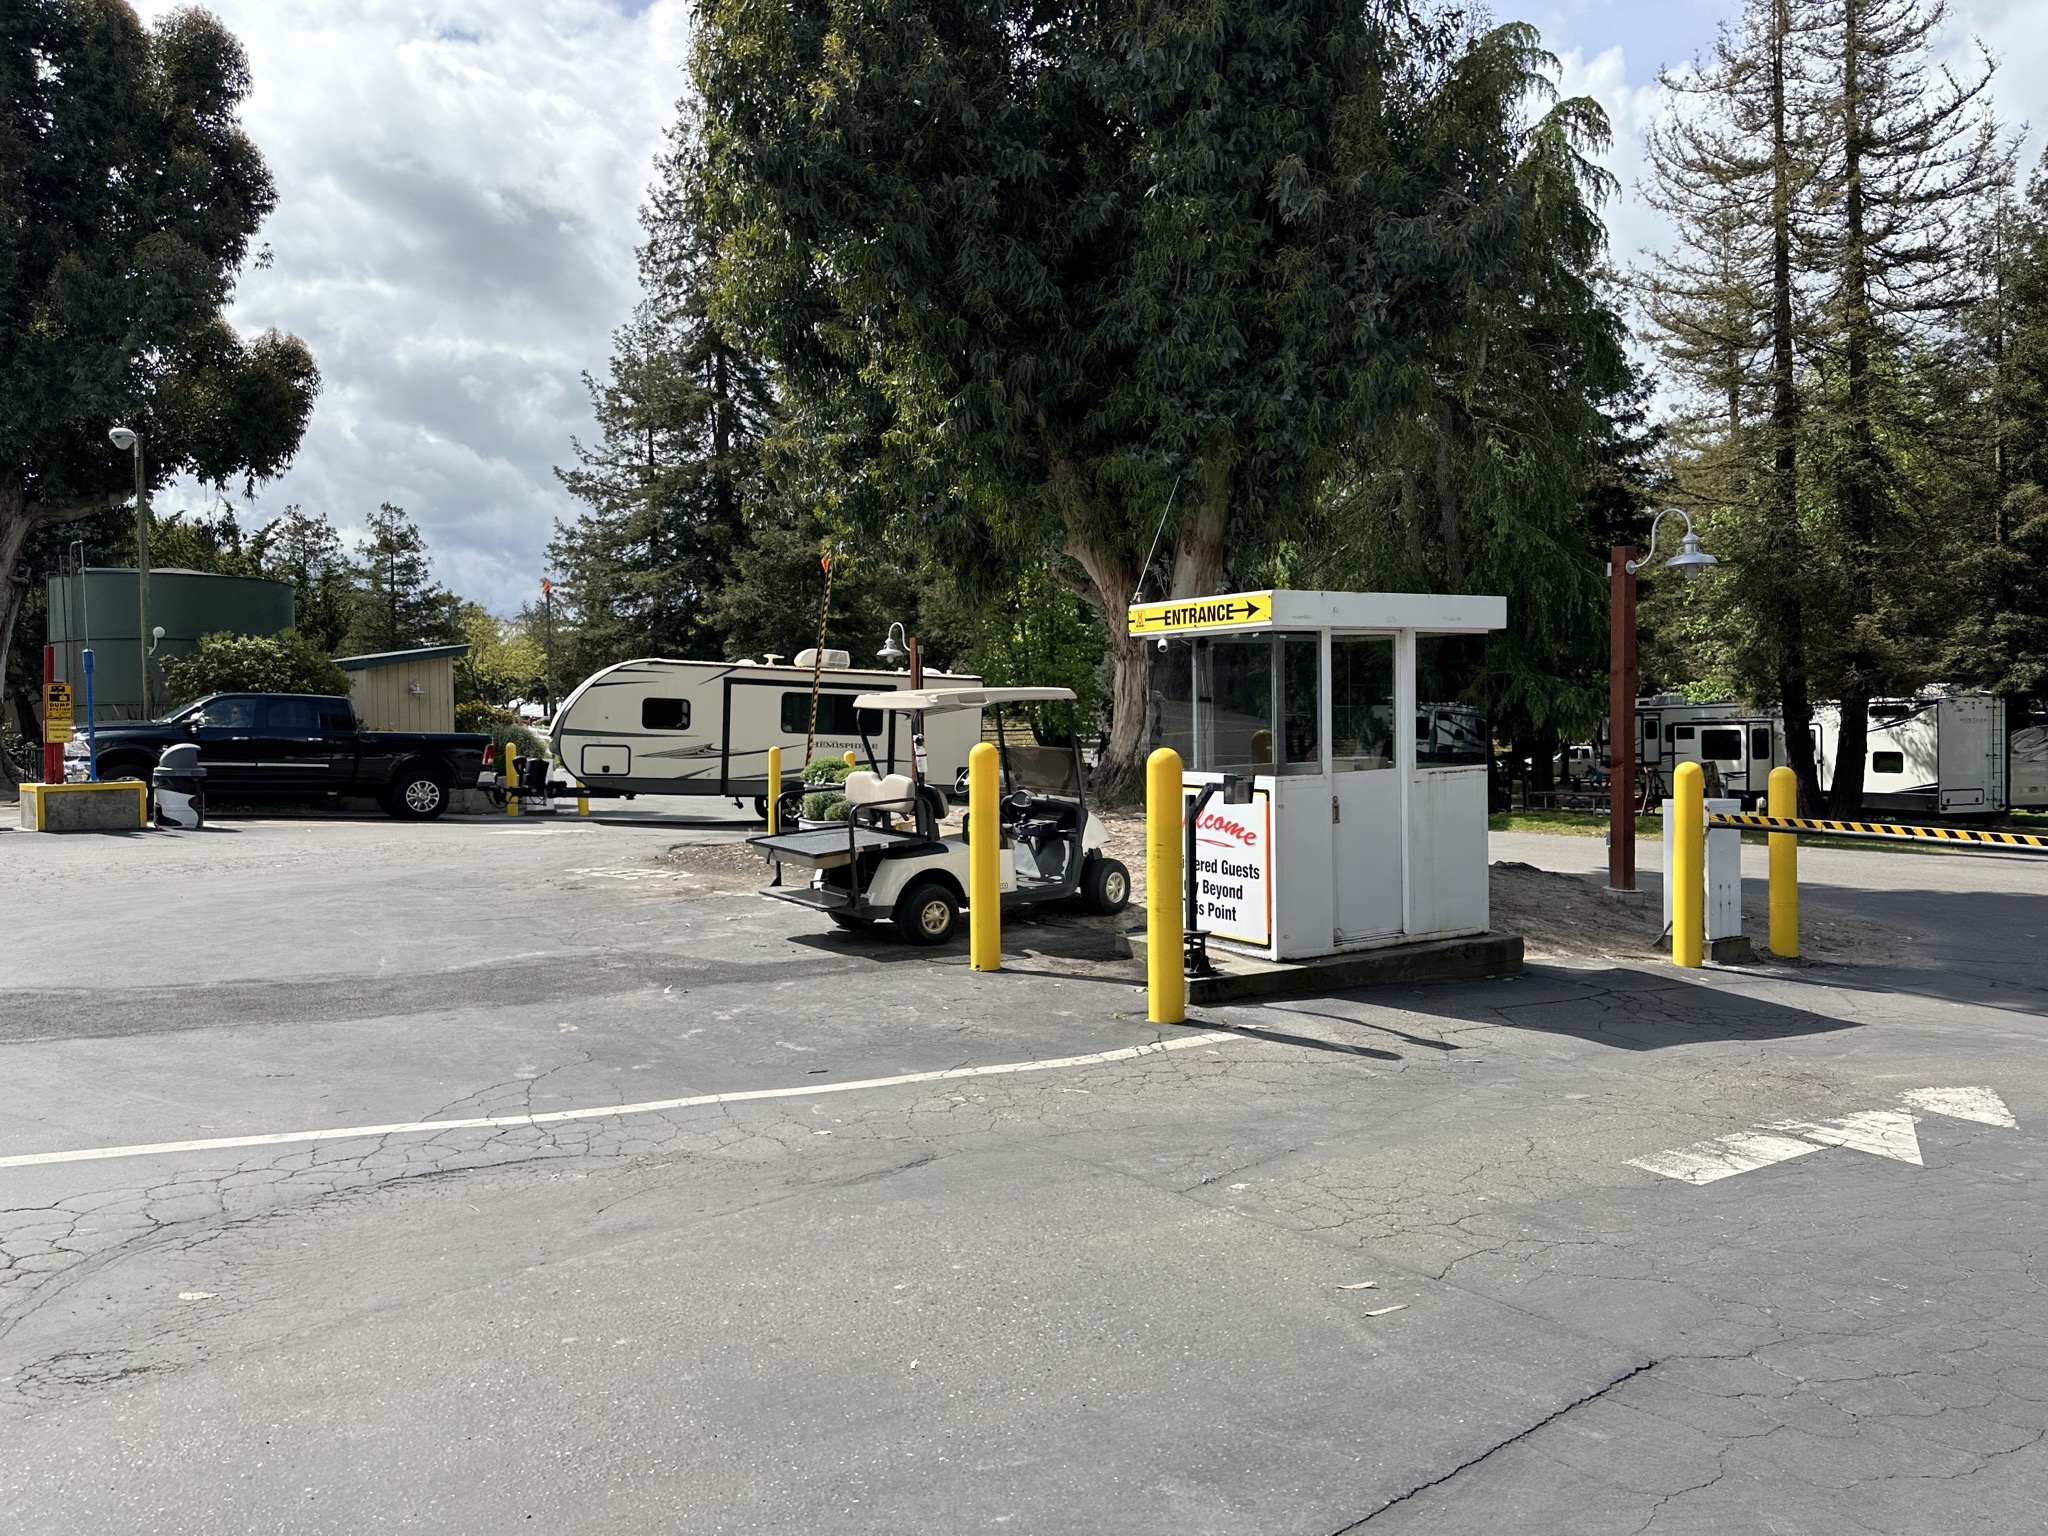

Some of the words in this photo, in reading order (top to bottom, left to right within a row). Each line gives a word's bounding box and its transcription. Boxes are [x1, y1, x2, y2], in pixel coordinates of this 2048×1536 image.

[1164, 603, 1234, 626] ENTRANCE
[813, 741, 878, 749] HEMISPHEE
[1182, 809, 1257, 846] lcome
[1221, 859, 1260, 880] Guests
[1202, 879, 1243, 900] Beyond
[1207, 902, 1237, 921] Point
